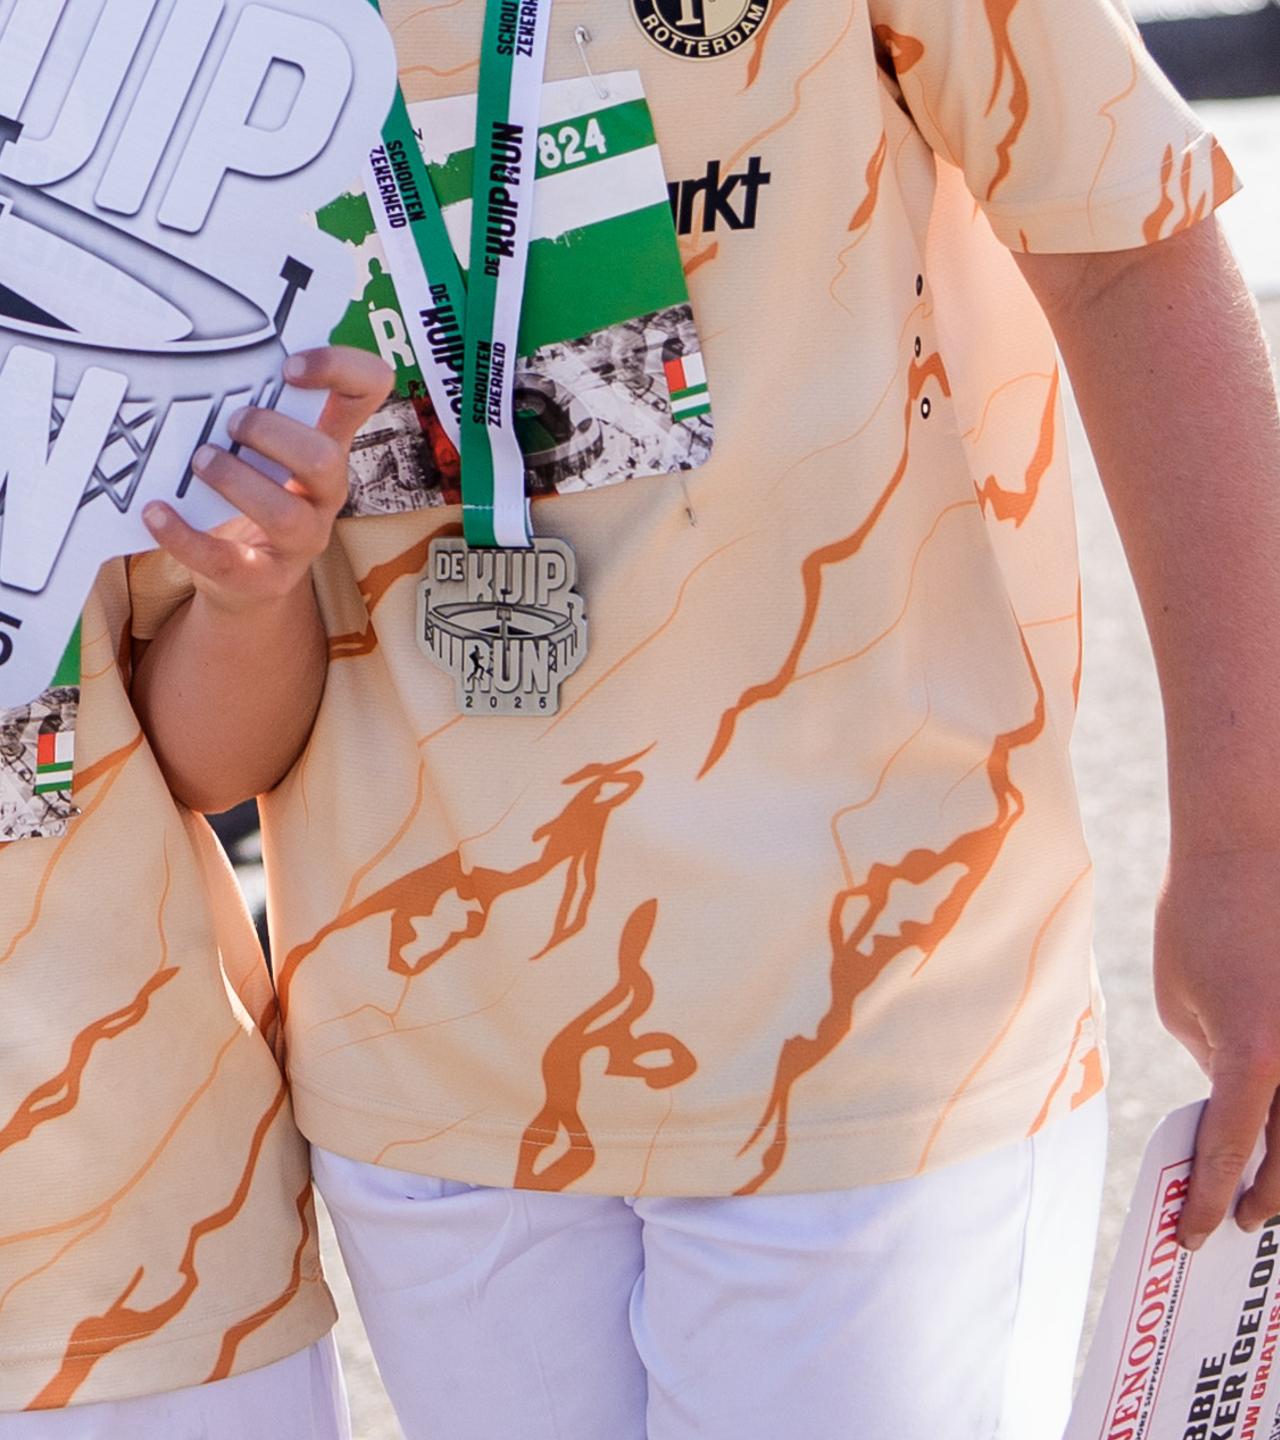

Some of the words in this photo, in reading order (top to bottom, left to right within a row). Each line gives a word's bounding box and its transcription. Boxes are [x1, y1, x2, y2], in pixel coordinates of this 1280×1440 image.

[642, 3, 765, 57] ROTTERDAM
[369, 145, 407, 230] ZEKERHEID
[385, 139, 427, 224] SCHOUTEN
[484, 254, 501, 278] DE
[429, 283, 451, 307] DE
[472, 340, 491, 426] SCHOUTEN
[487, 341, 507, 429] ZEKERHEID
[436, 550, 465, 582] DE
[467, 550, 567, 606] KUIP
[462, 638, 550, 694] RUN
